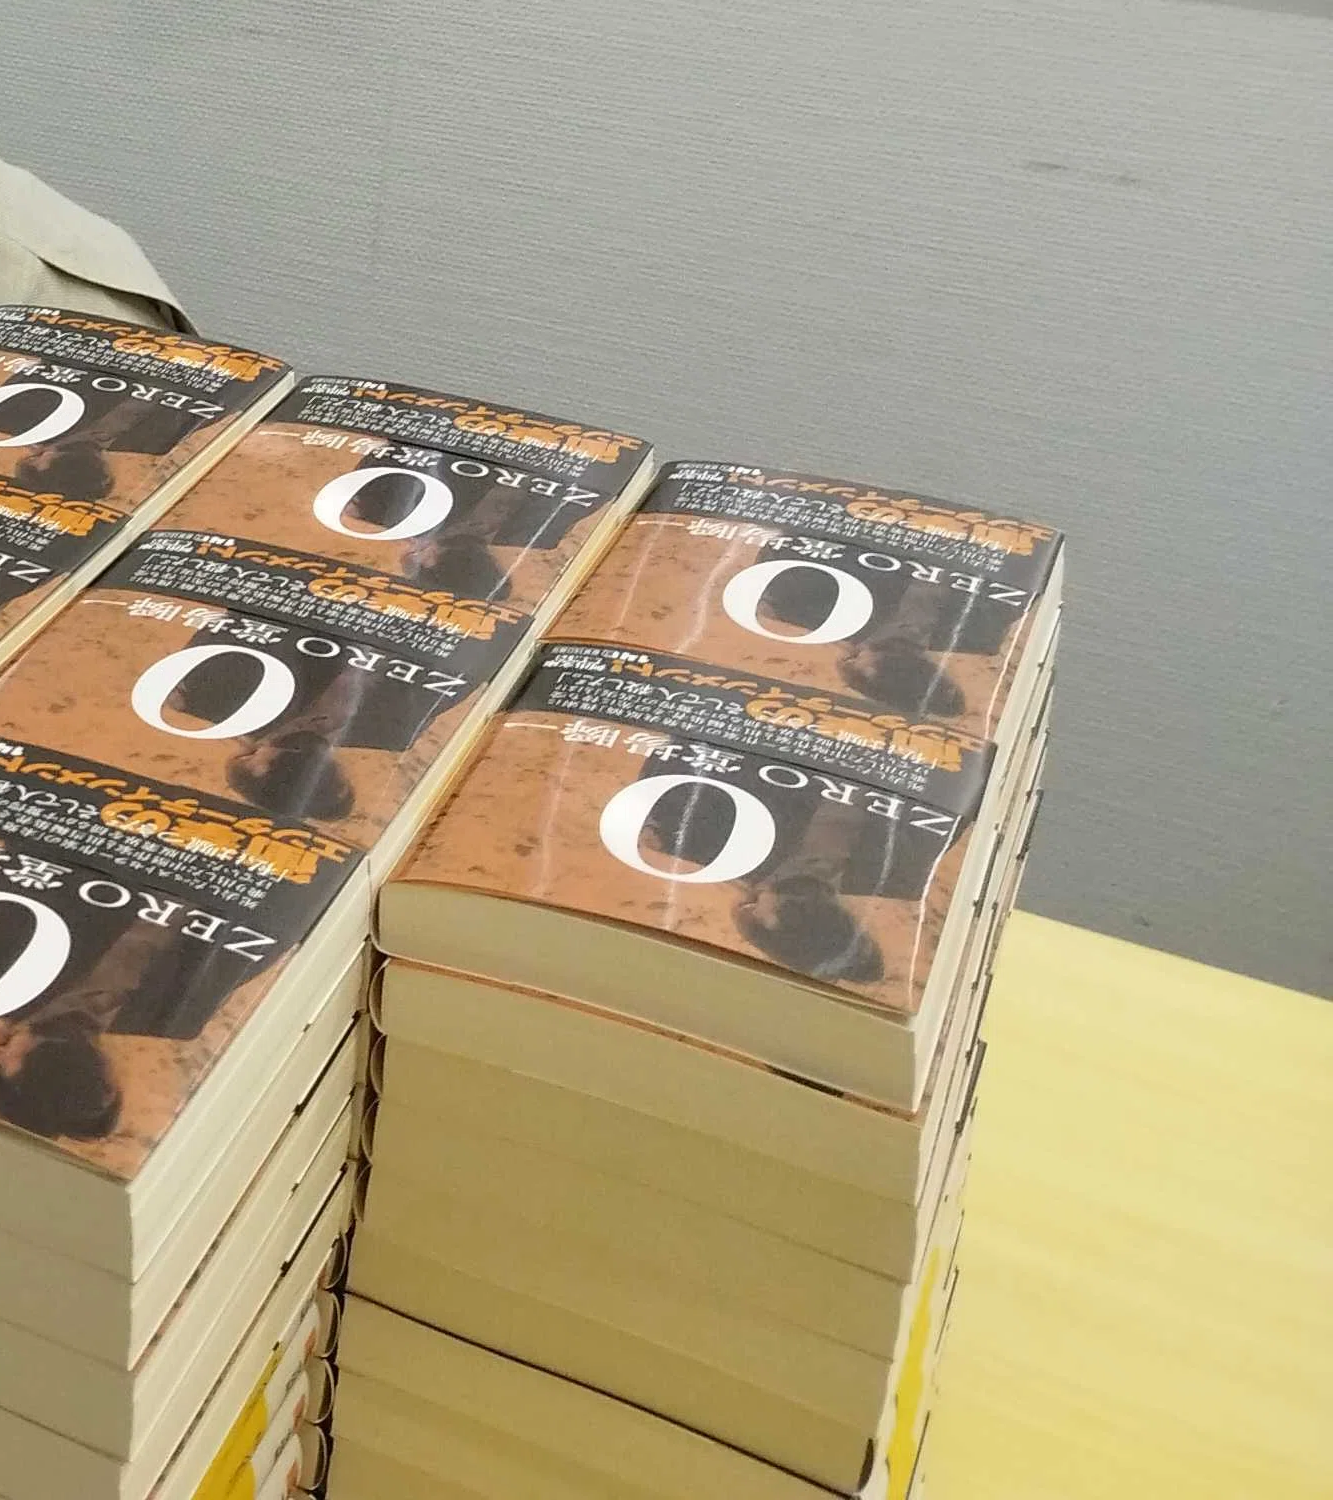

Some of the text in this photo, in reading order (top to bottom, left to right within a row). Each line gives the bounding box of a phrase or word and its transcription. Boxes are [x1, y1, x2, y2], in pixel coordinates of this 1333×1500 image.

[92, 377, 226, 418] ZERO
[258, 428, 442, 464] 堂場瞬一
[451, 460, 601, 507] ZERO
[312, 467, 452, 540] 0
[637, 517, 845, 556] 堂場瞬一
[194, 542, 520, 625] エンターテインメント!
[722, 560, 872, 643] 0
[857, 552, 1027, 606] ZERO
[81, 596, 469, 697] ZERO 堂場瞬一
[130, 645, 294, 738] 0
[608, 659, 985, 753] エンターテインメント!
[503, 718, 956, 839] ZERO 堂場瞬一
[598, 774, 774, 883] 0
[80, 879, 278, 962] ZERO
